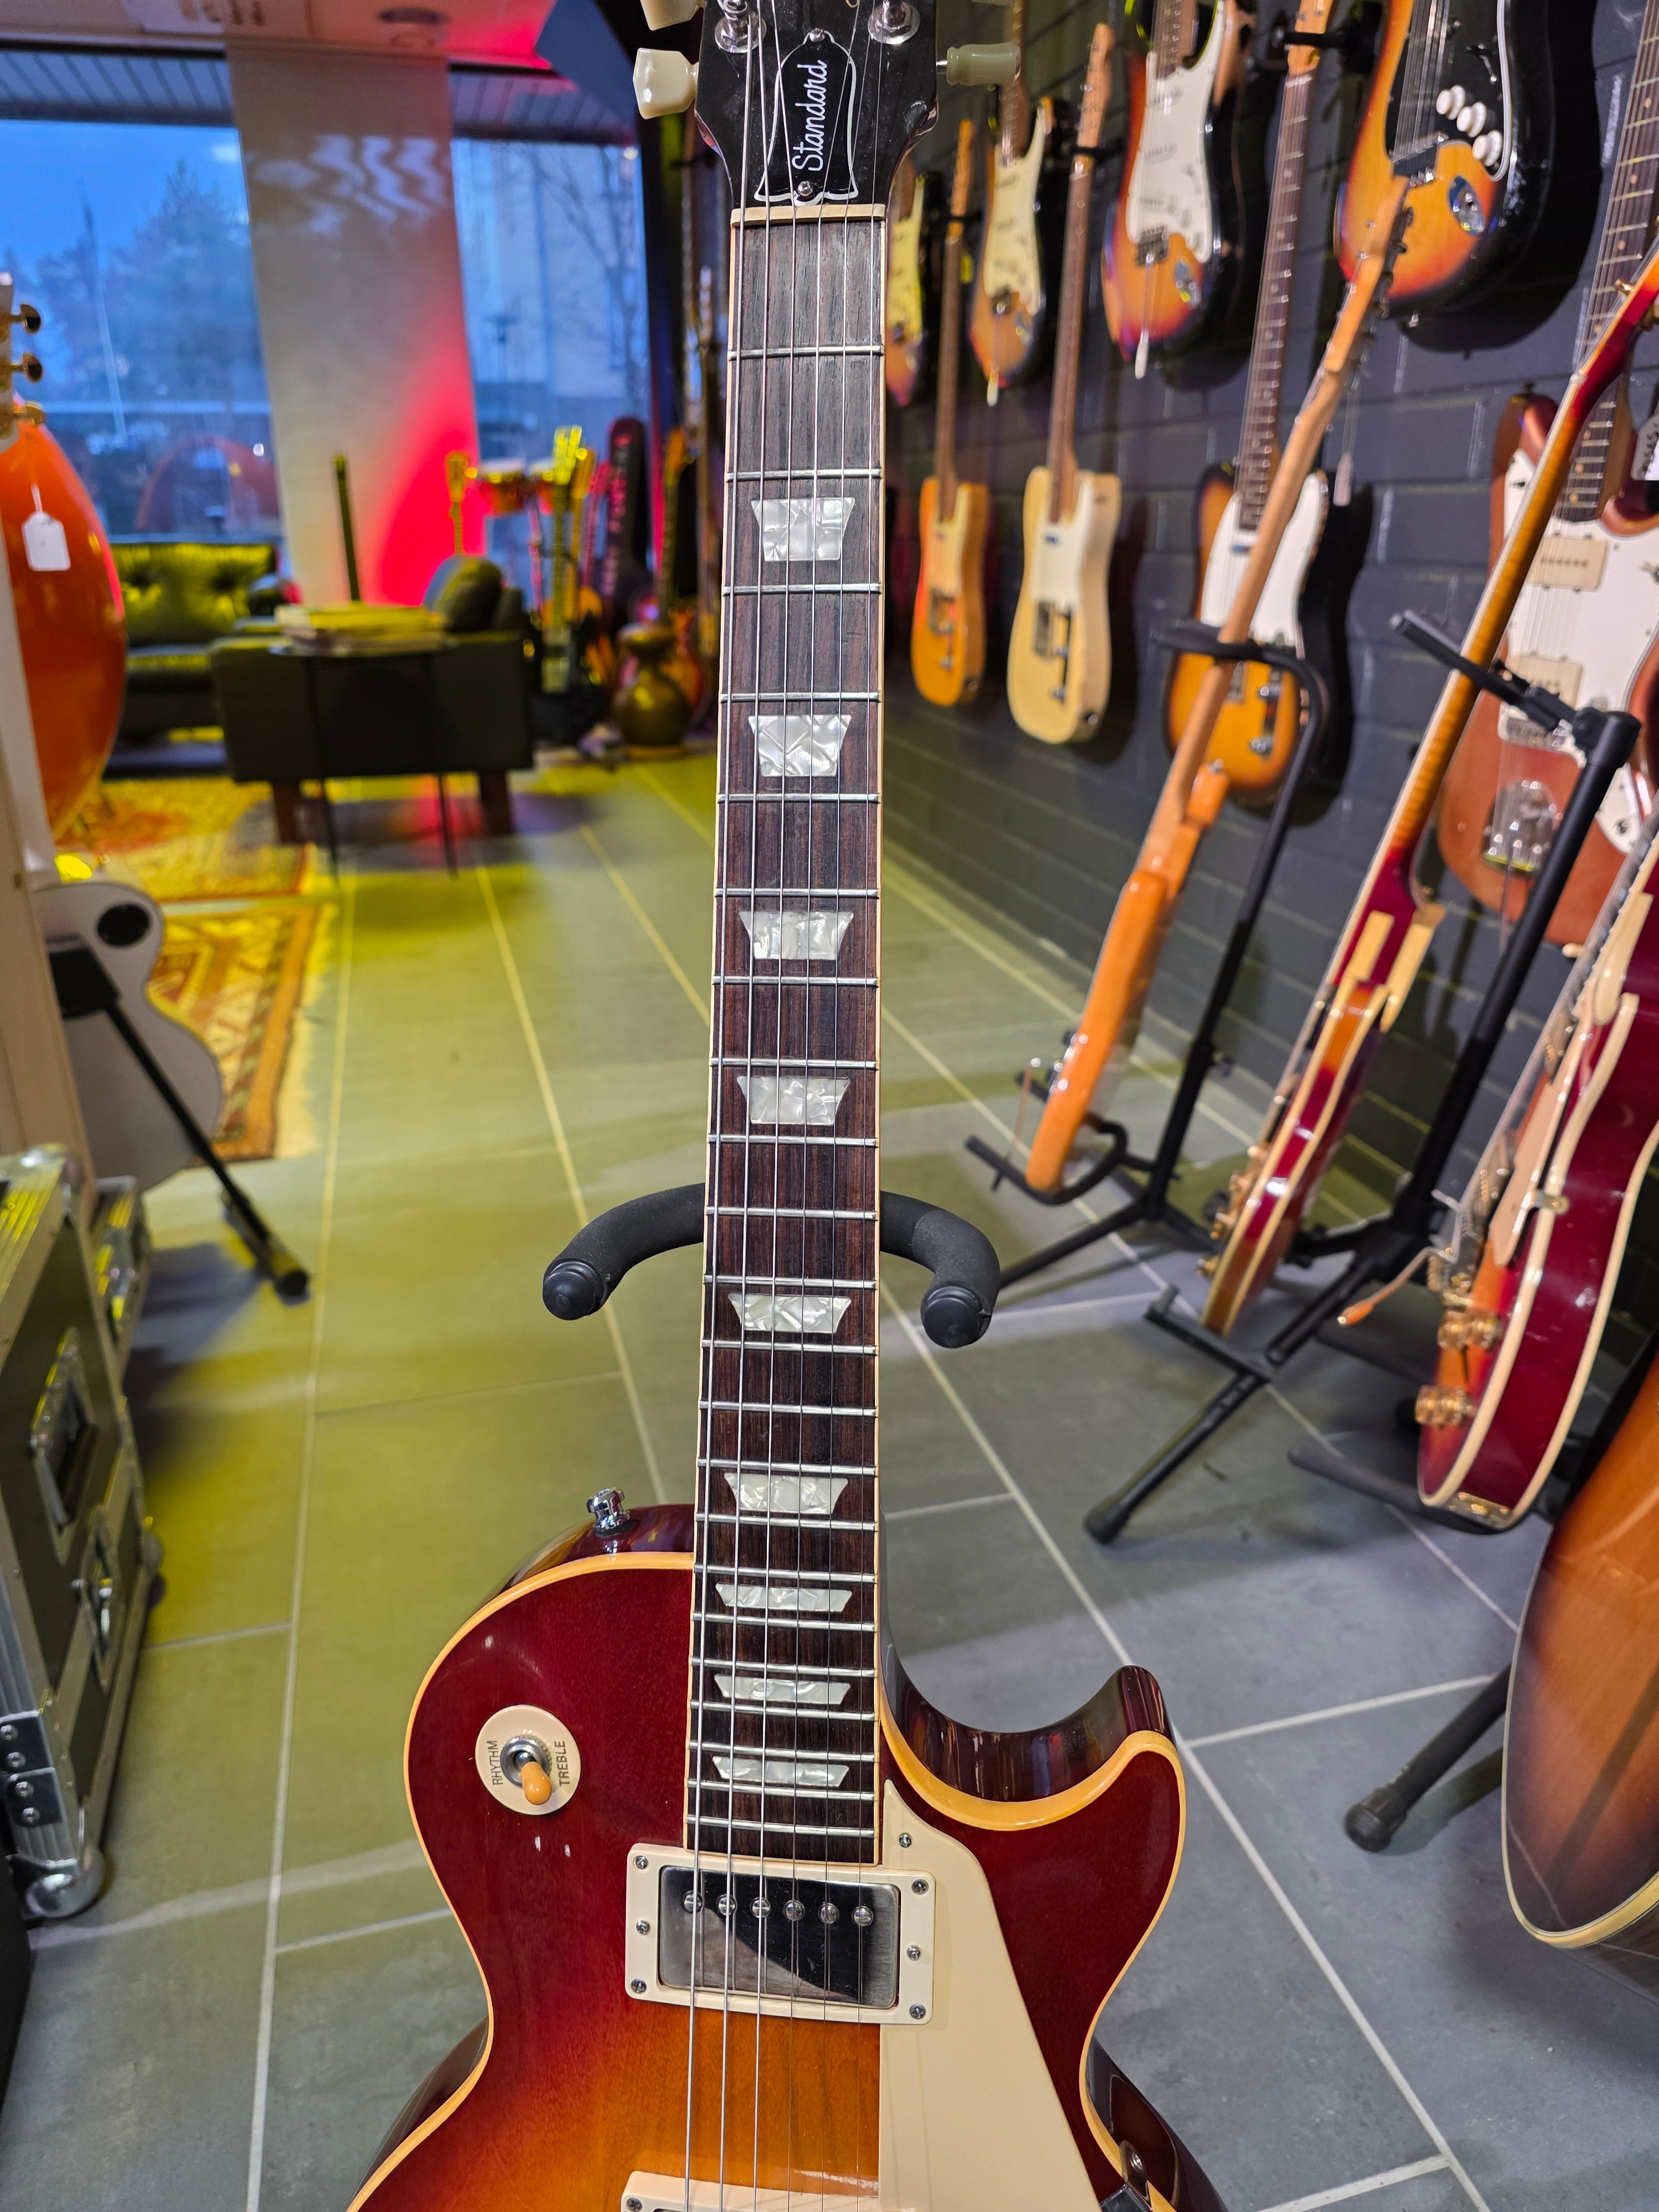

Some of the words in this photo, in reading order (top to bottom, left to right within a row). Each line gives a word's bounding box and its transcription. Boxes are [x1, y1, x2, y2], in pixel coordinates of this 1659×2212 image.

[791, 60, 827, 171] Standard
[487, 1740, 503, 1785] RHYTHM
[554, 1740, 570, 1787] TREBLE
